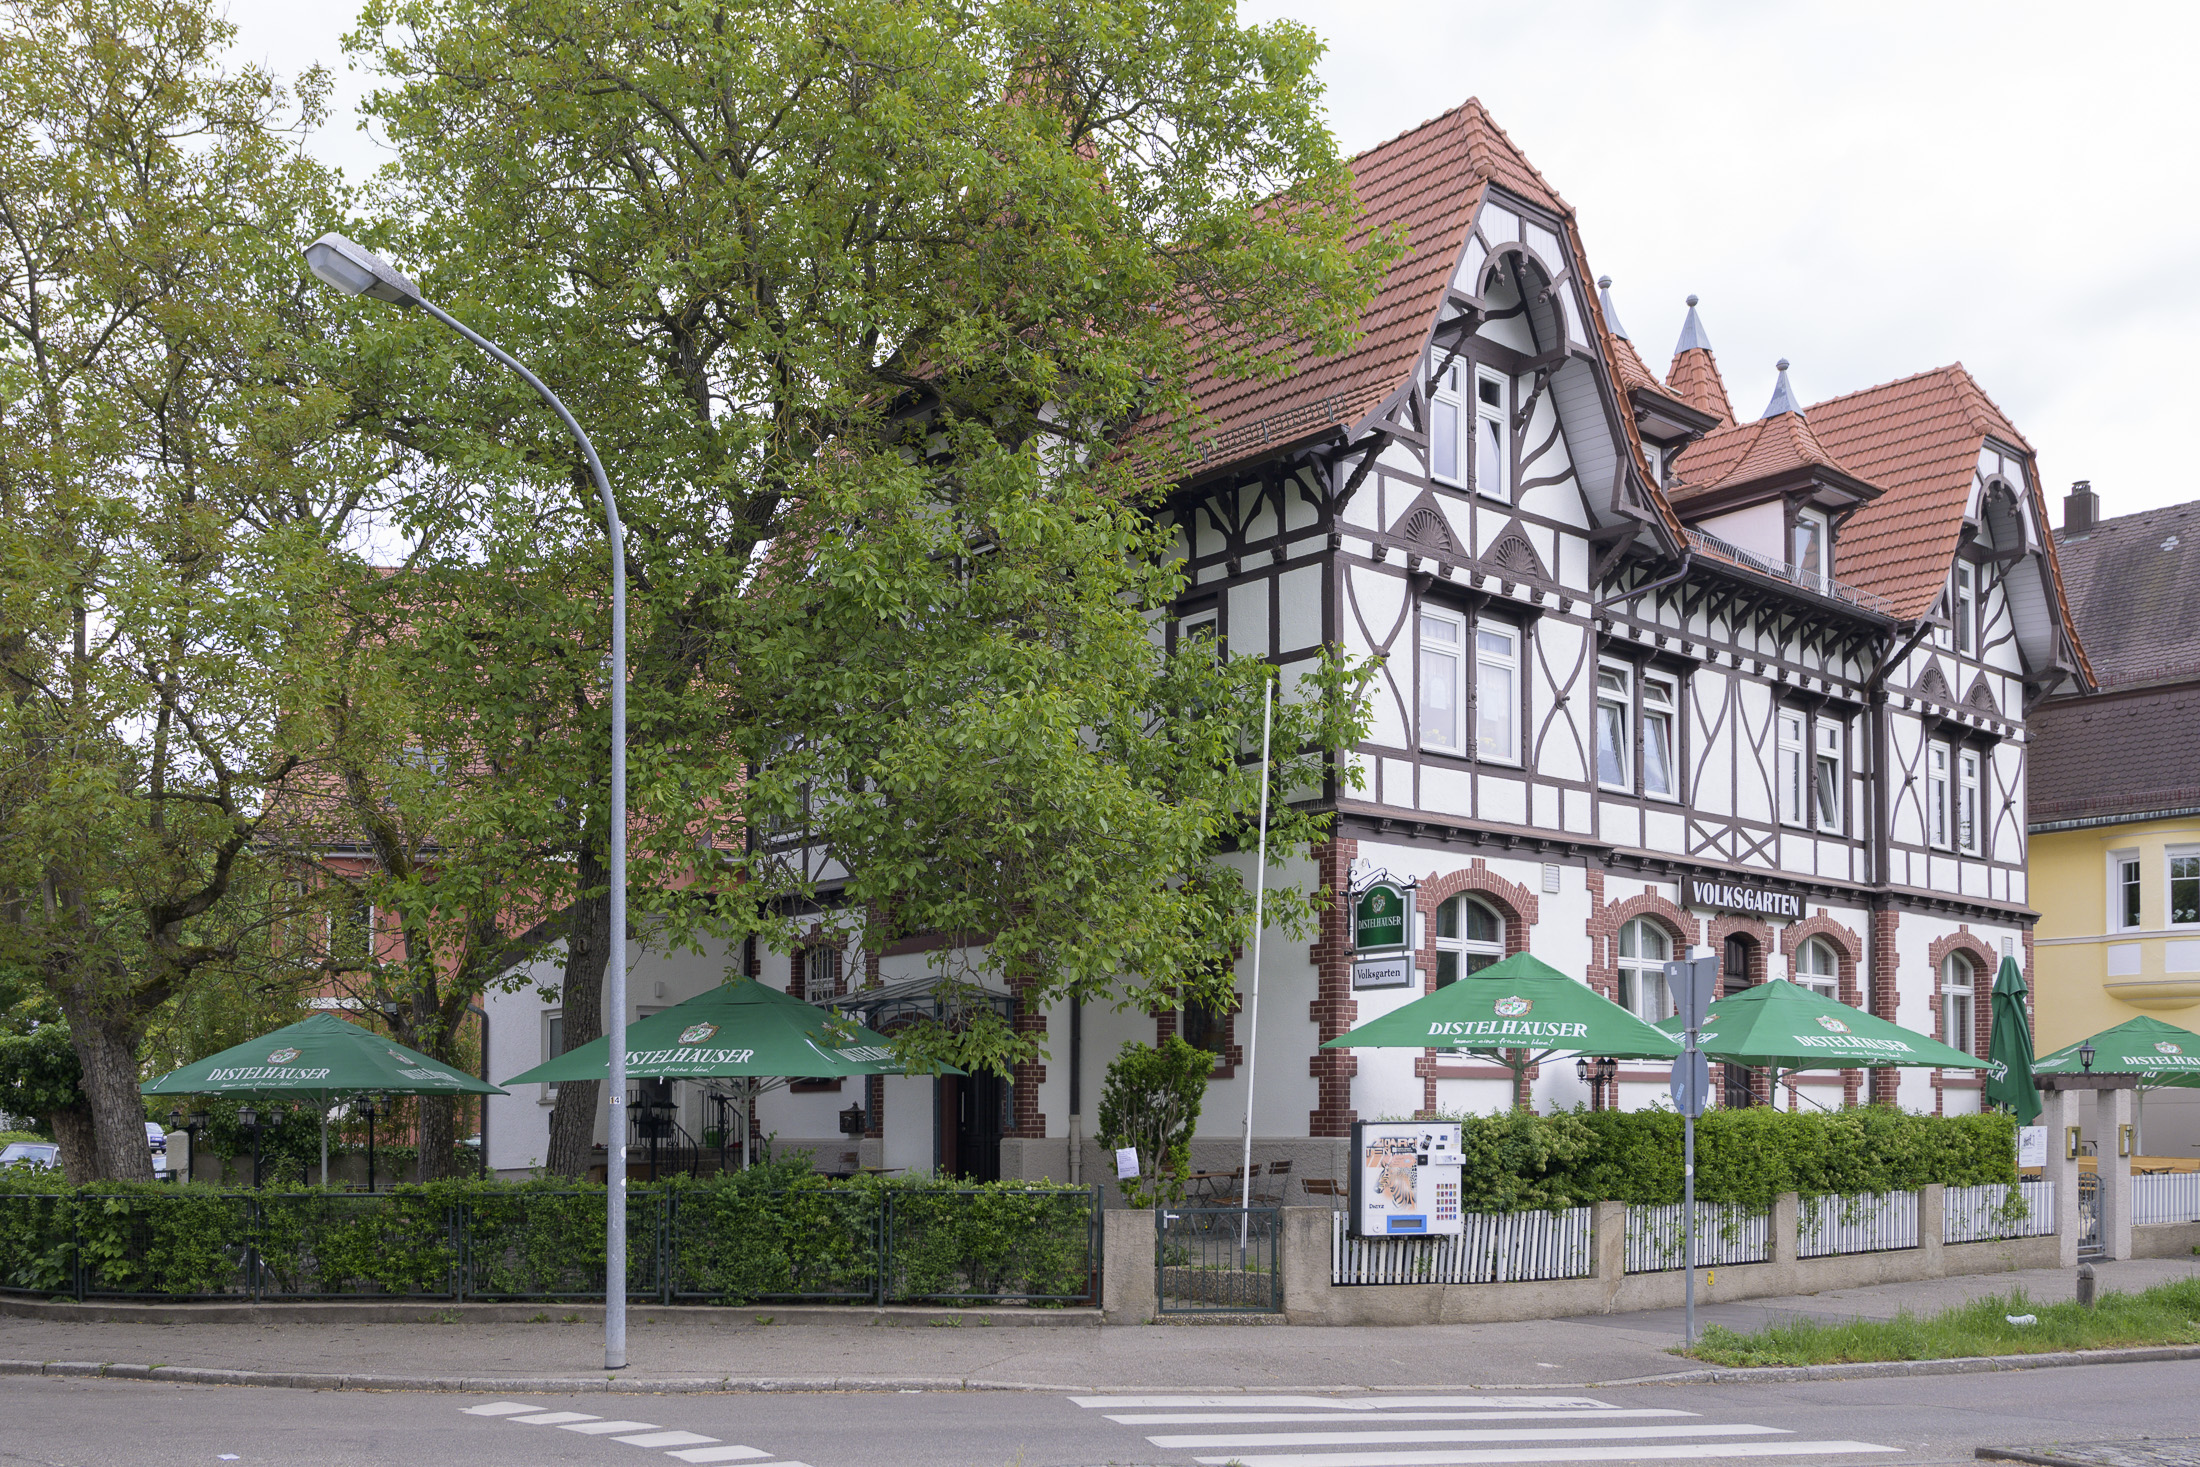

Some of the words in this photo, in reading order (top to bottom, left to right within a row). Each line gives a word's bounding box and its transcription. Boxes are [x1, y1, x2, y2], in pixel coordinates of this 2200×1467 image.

[1692, 881, 1799, 916] VOLKSGARTEN
[1357, 968, 1401, 980] Volksgarten
[1426, 1020, 1588, 1038] DISTELHÄUSER
[604, 1048, 755, 1067] ISTELHÄUSER
[206, 1067, 330, 1081] DISTELHÄUSER
